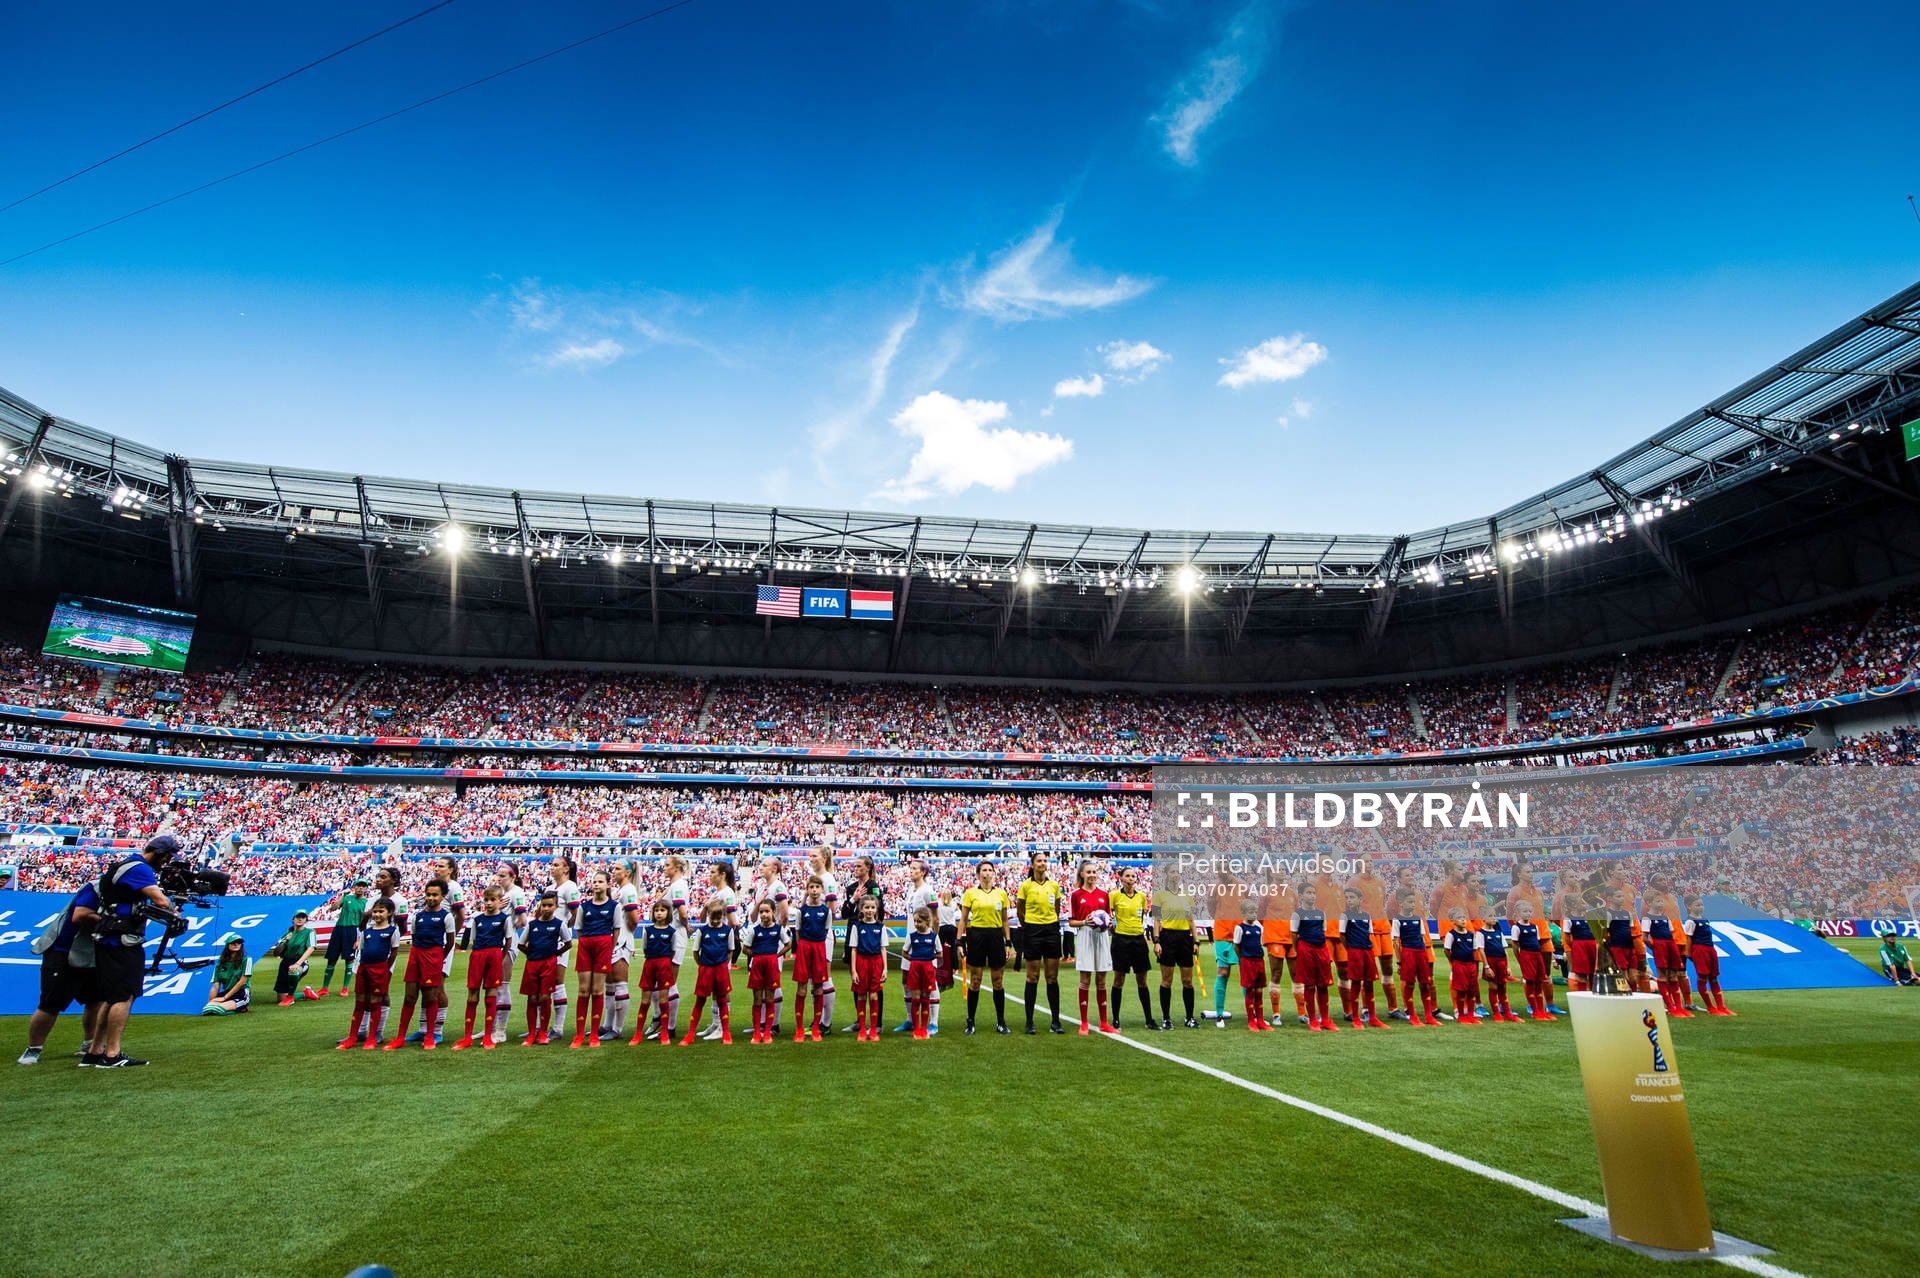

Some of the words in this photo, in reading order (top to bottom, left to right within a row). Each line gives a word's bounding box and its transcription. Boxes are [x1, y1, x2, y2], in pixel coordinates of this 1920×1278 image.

[810, 597, 839, 608] FIFA
[1657, 840, 1677, 848] LYON
[1636, 1078, 1670, 1087] FRANCE
[1630, 1094, 1669, 1103] ORIGINAL
